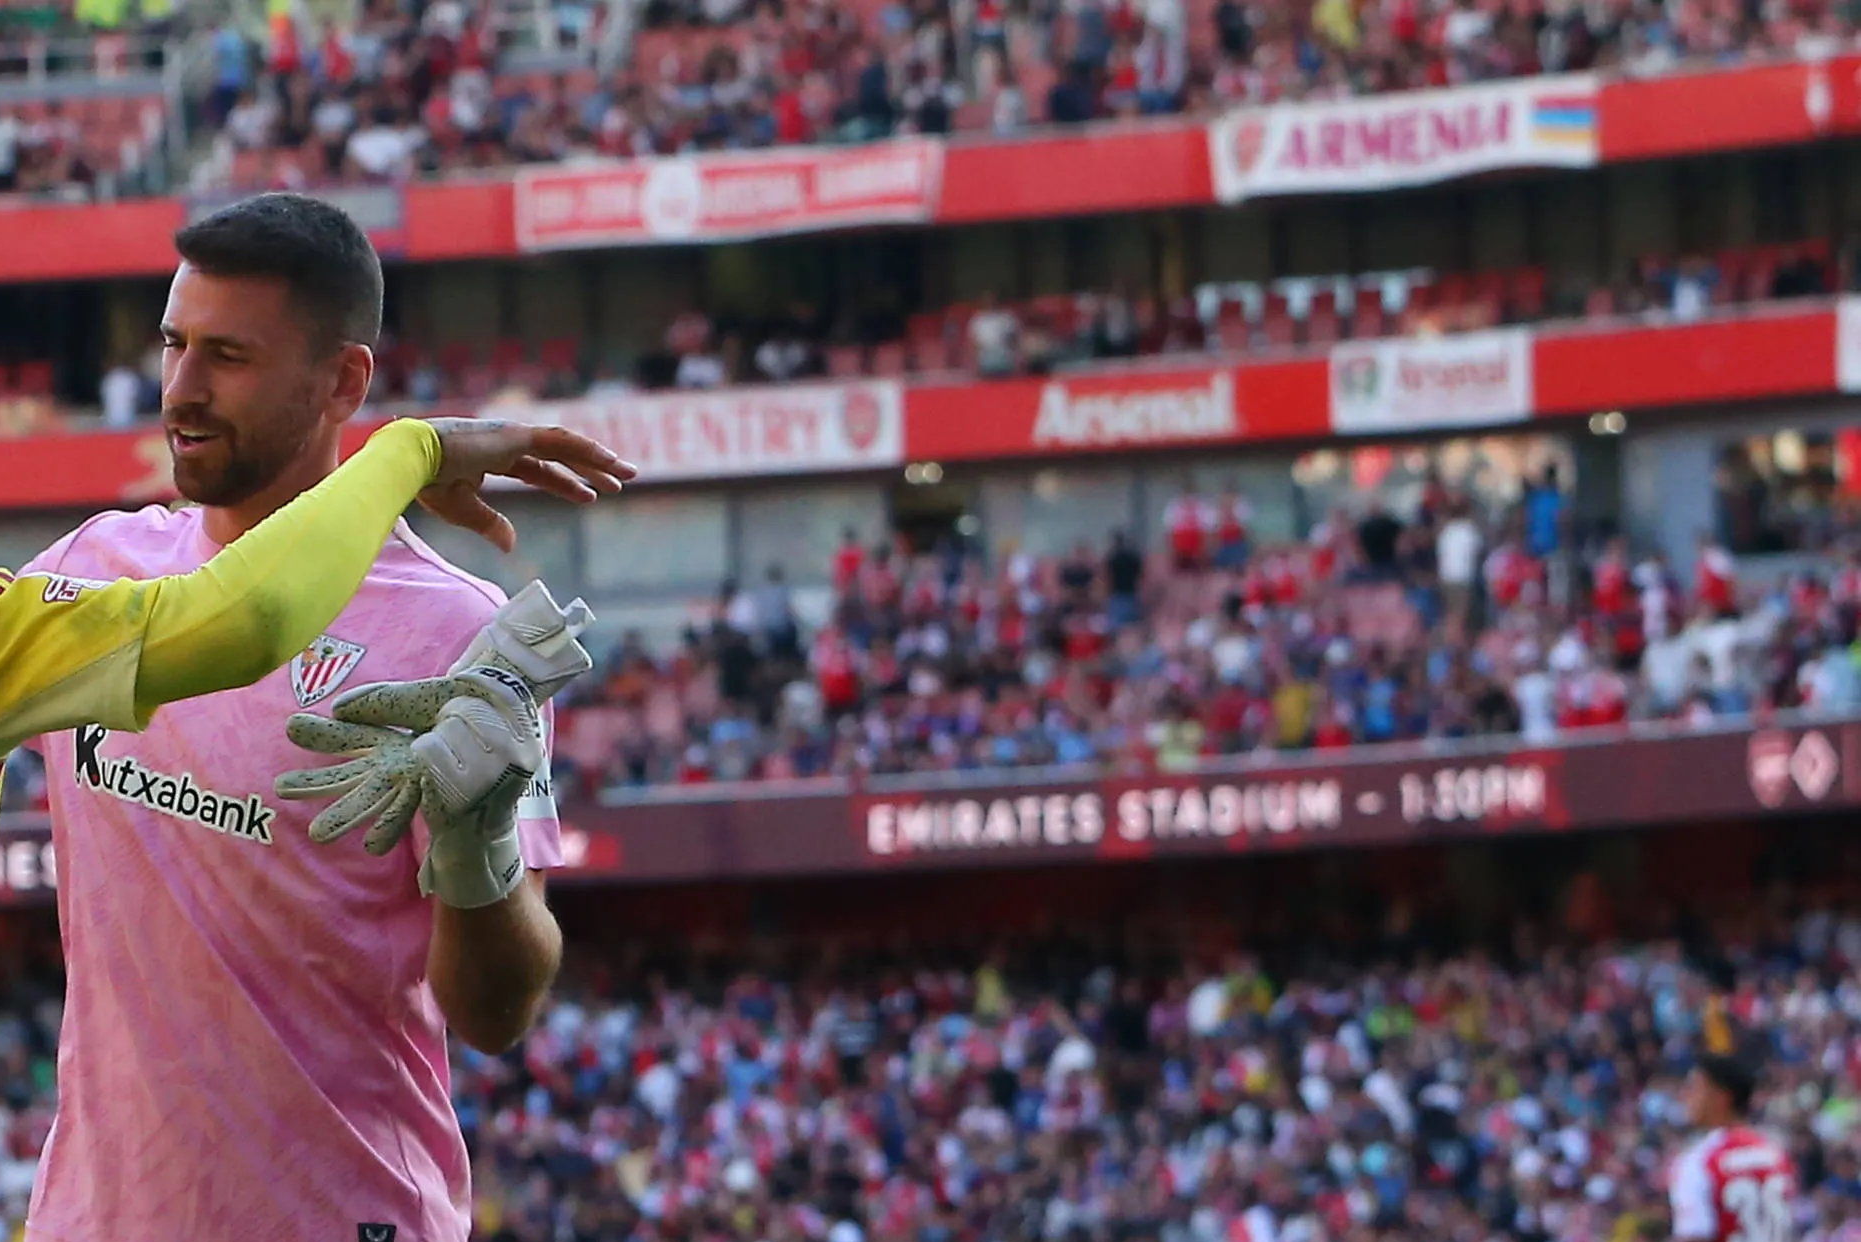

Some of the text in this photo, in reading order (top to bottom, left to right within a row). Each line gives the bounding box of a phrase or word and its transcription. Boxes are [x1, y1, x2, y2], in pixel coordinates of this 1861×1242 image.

[1032, 373, 1236, 447] Arsenal
[74, 723, 273, 840] Kutxabank
[867, 793, 1104, 855] EMIRATES
[1117, 784, 1341, 842] STADIUM
